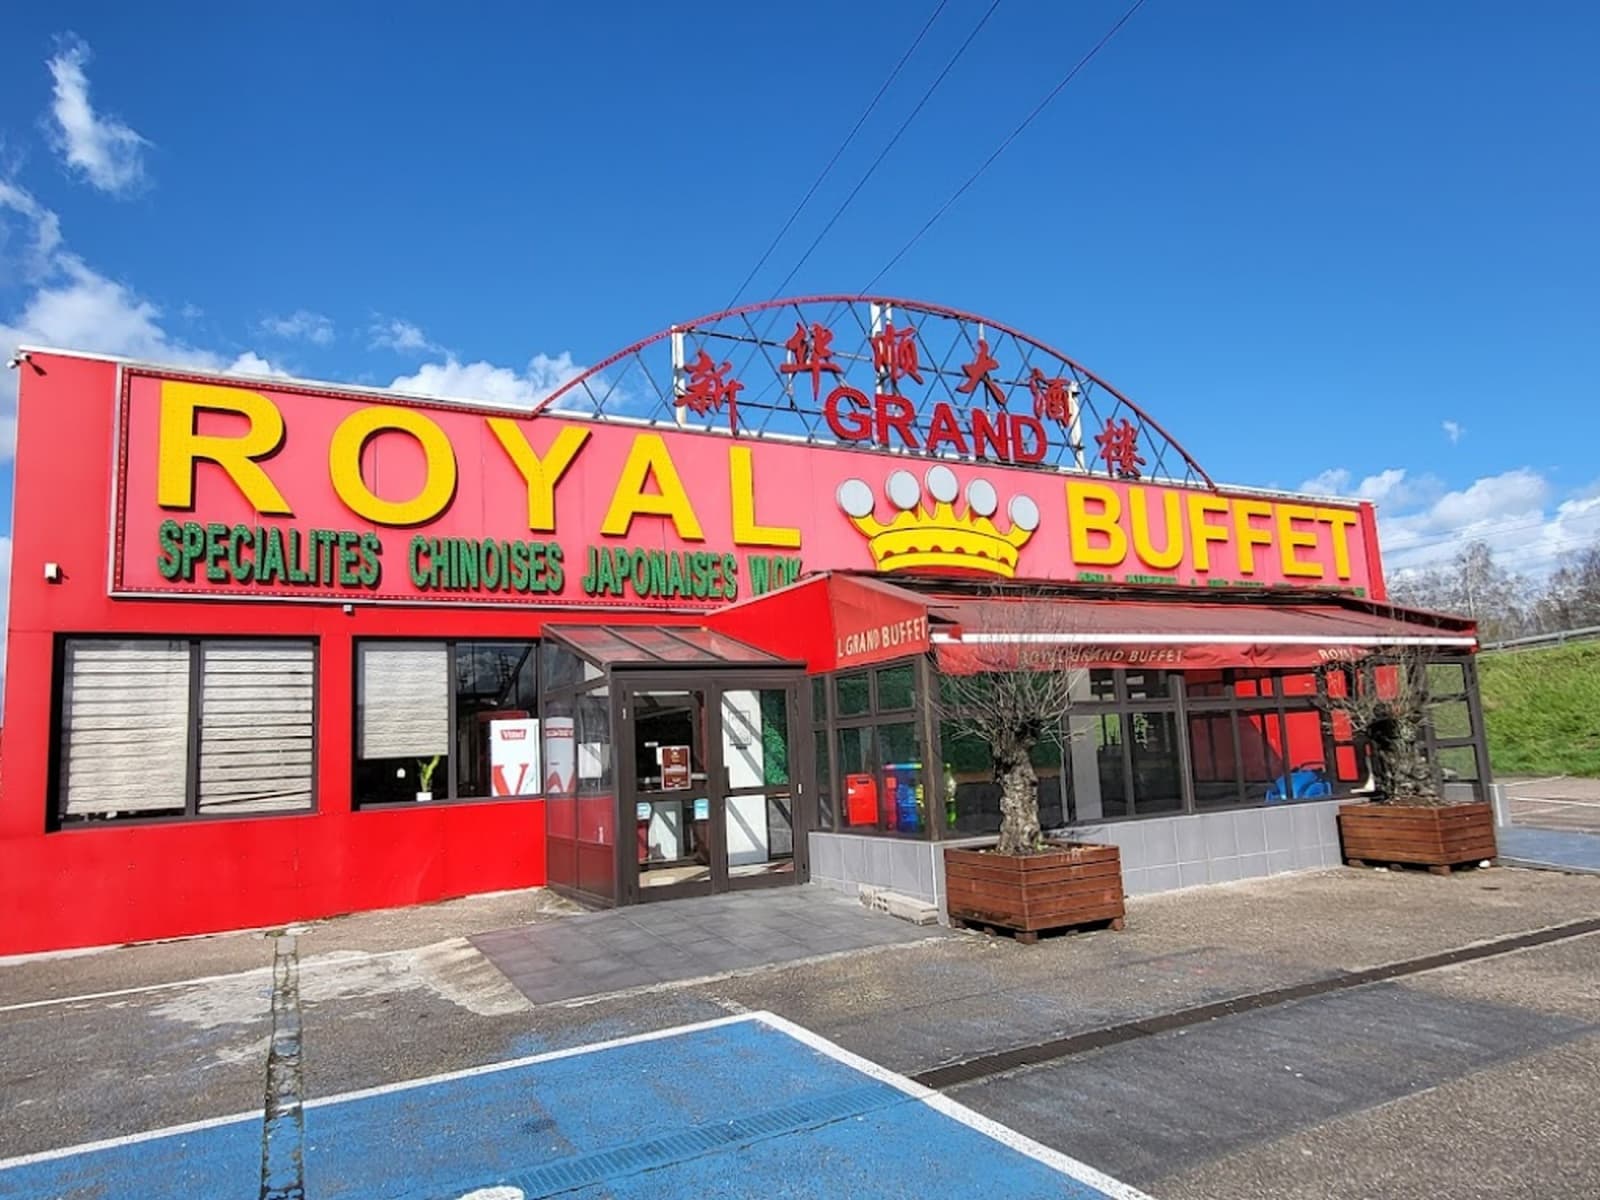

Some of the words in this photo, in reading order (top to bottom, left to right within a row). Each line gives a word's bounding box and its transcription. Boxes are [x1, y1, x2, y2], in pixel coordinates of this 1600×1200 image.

[158, 380, 802, 548] ROYAL
[824, 386, 1048, 464] GRAND
[157, 520, 380, 587] SPECIALITES
[409, 536, 564, 593] CHINOISES
[582, 545, 739, 601] JAPONAISES
[1065, 481, 1359, 580] BUFFET
[845, 628, 880, 656] GRAND
[881, 616, 926, 649] BUFFET
[1127, 650, 1184, 663] BUFFET
